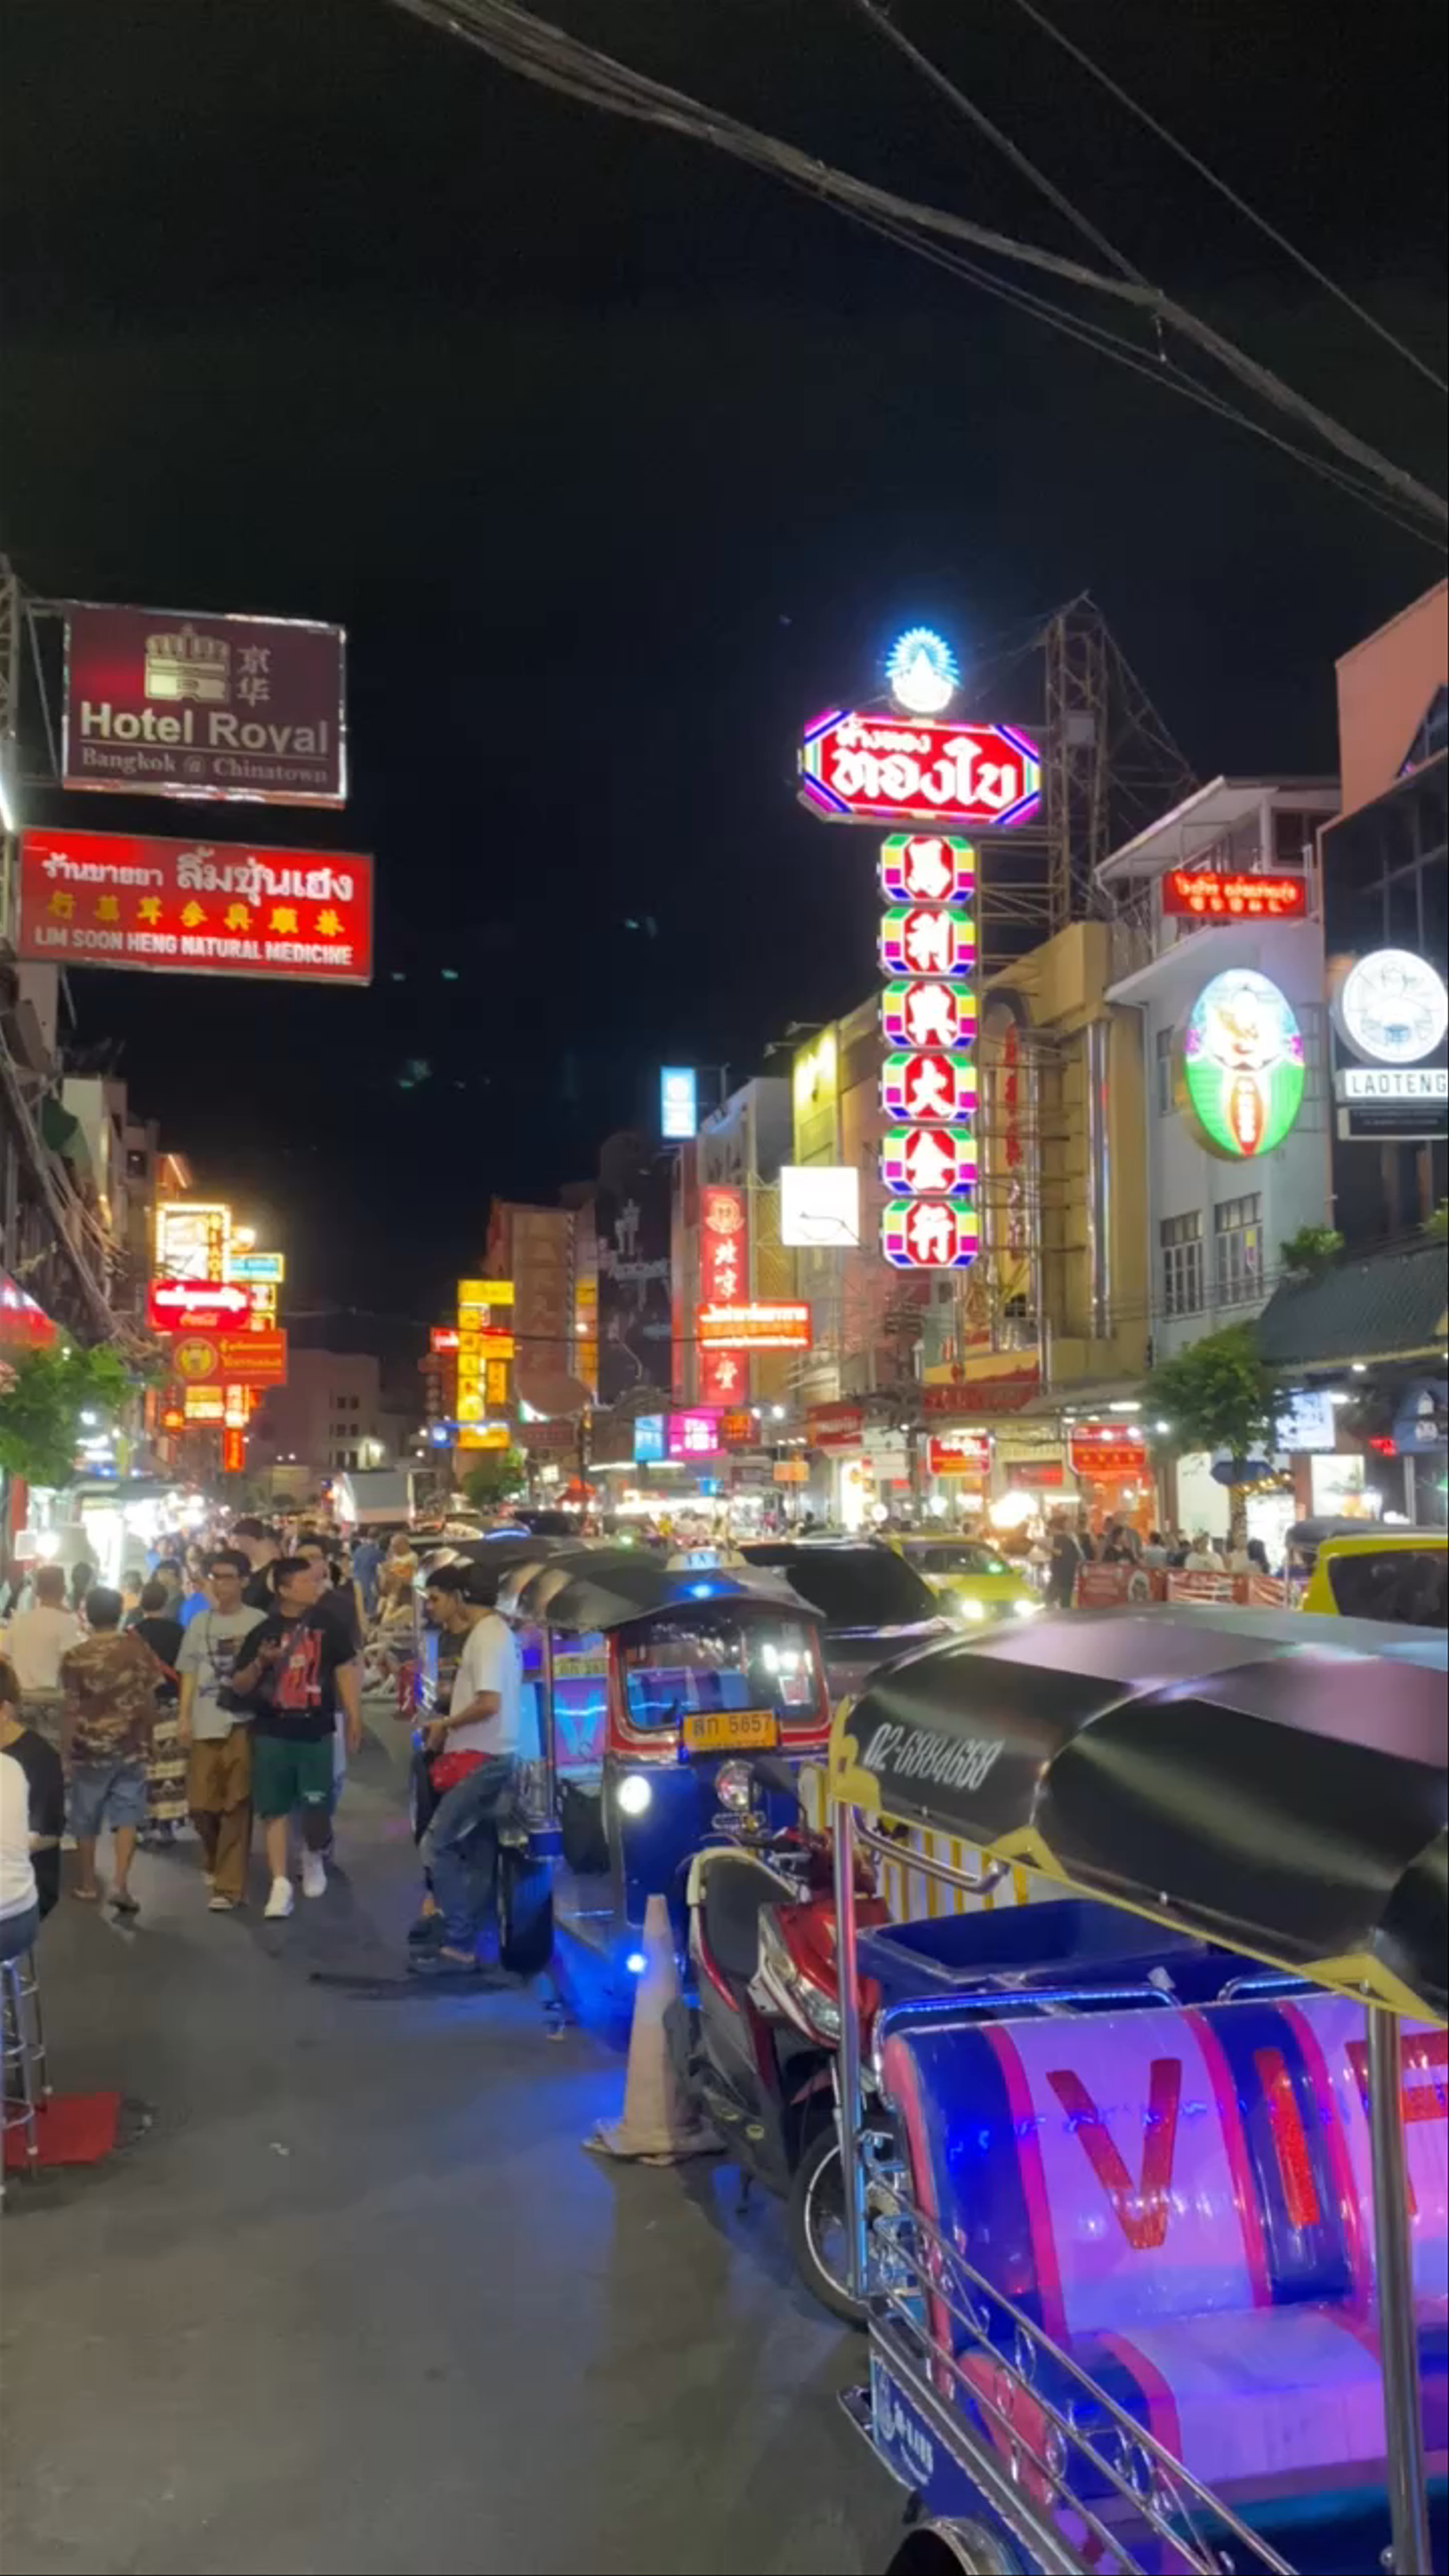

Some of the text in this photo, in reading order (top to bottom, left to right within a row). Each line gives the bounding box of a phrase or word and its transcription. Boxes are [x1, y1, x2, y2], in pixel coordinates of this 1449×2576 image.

[81, 701, 328, 753] Hotel Royal
[82, 747, 176, 774] Bangkok
[213, 758, 328, 783] Chinatown
[35, 927, 354, 966] LIM SOON HENG NATURAL MEDICINE
[1352, 1074, 1447, 1094] LAOTENG
